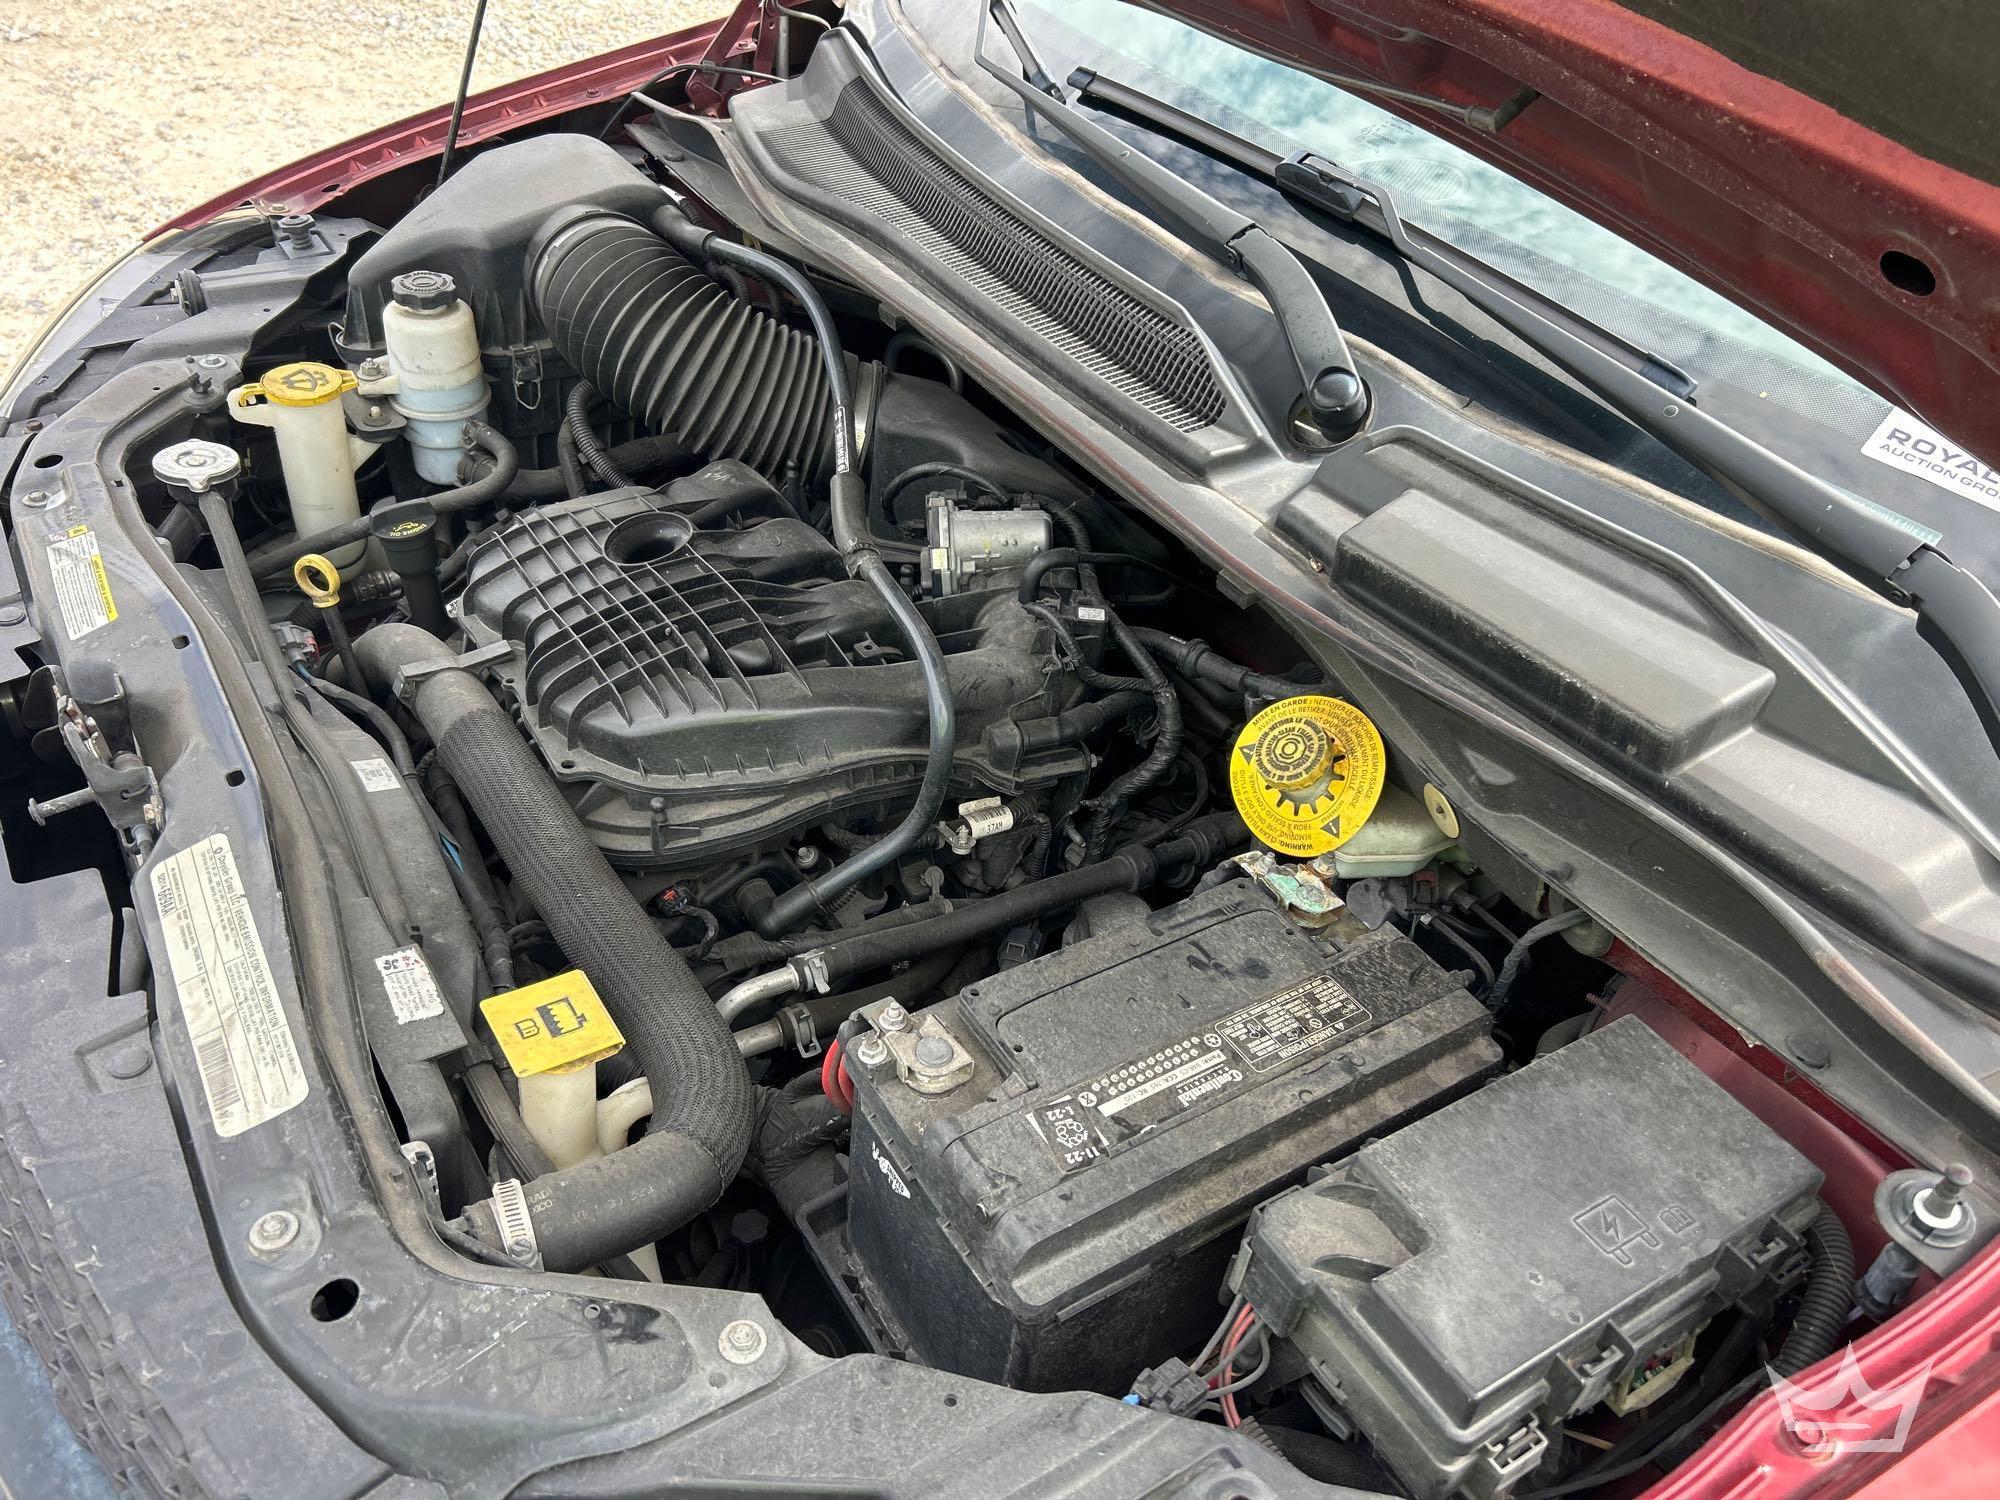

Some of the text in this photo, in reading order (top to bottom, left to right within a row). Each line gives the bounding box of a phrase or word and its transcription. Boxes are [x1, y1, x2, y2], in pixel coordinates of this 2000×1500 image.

[1886, 427, 1999, 485] ROYAL
[1879, 443, 2000, 500] AUCTION GRO
[1268, 703, 1281, 714] EN
[1280, 699, 1307, 709] GARDE
[1313, 699, 1346, 713] NETTOYER
[1344, 708, 1354, 718] LE
[1251, 711, 1268, 727] MISE
[1256, 713, 1277, 733] AVANT
[1276, 710, 1287, 719] DE
[1326, 709, 1353, 729] UTILISER
[1351, 714, 1374, 742] BOUCHON
[1349, 726, 1368, 768] UNIQUEMENT
[1368, 742, 1377, 753] DE
[1239, 768, 1247, 790] FLUID
[1360, 768, 1367, 778] DU
[1363, 752, 1378, 800] REMPLISSAGE
[1244, 794, 1255, 810] DOT
[1348, 780, 1366, 809] LIQUIDE
[1231, 769, 1313, 851] WARNING: CLEAN FILLER CAP BEFORE
[1251, 807, 1267, 826] ONLY
[1263, 808, 1287, 828] SEALED
[1264, 821, 1278, 834] USE
[1285, 821, 1293, 830] A
[1291, 822, 1312, 831] FROM
[217, 854, 229, 876] Chrysler
[224, 876, 234, 894] Group
[234, 908, 248, 931] VEHICLE
[241, 931, 256, 958] EMISSION
[250, 958, 265, 986] CONTROL
[259, 986, 279, 1027] INFORMATION
[1277, 1027, 1336, 1058] DANGER/POISON
[1178, 1069, 1242, 1106] Continental
[1064, 1146, 1099, 1163] 11-22
